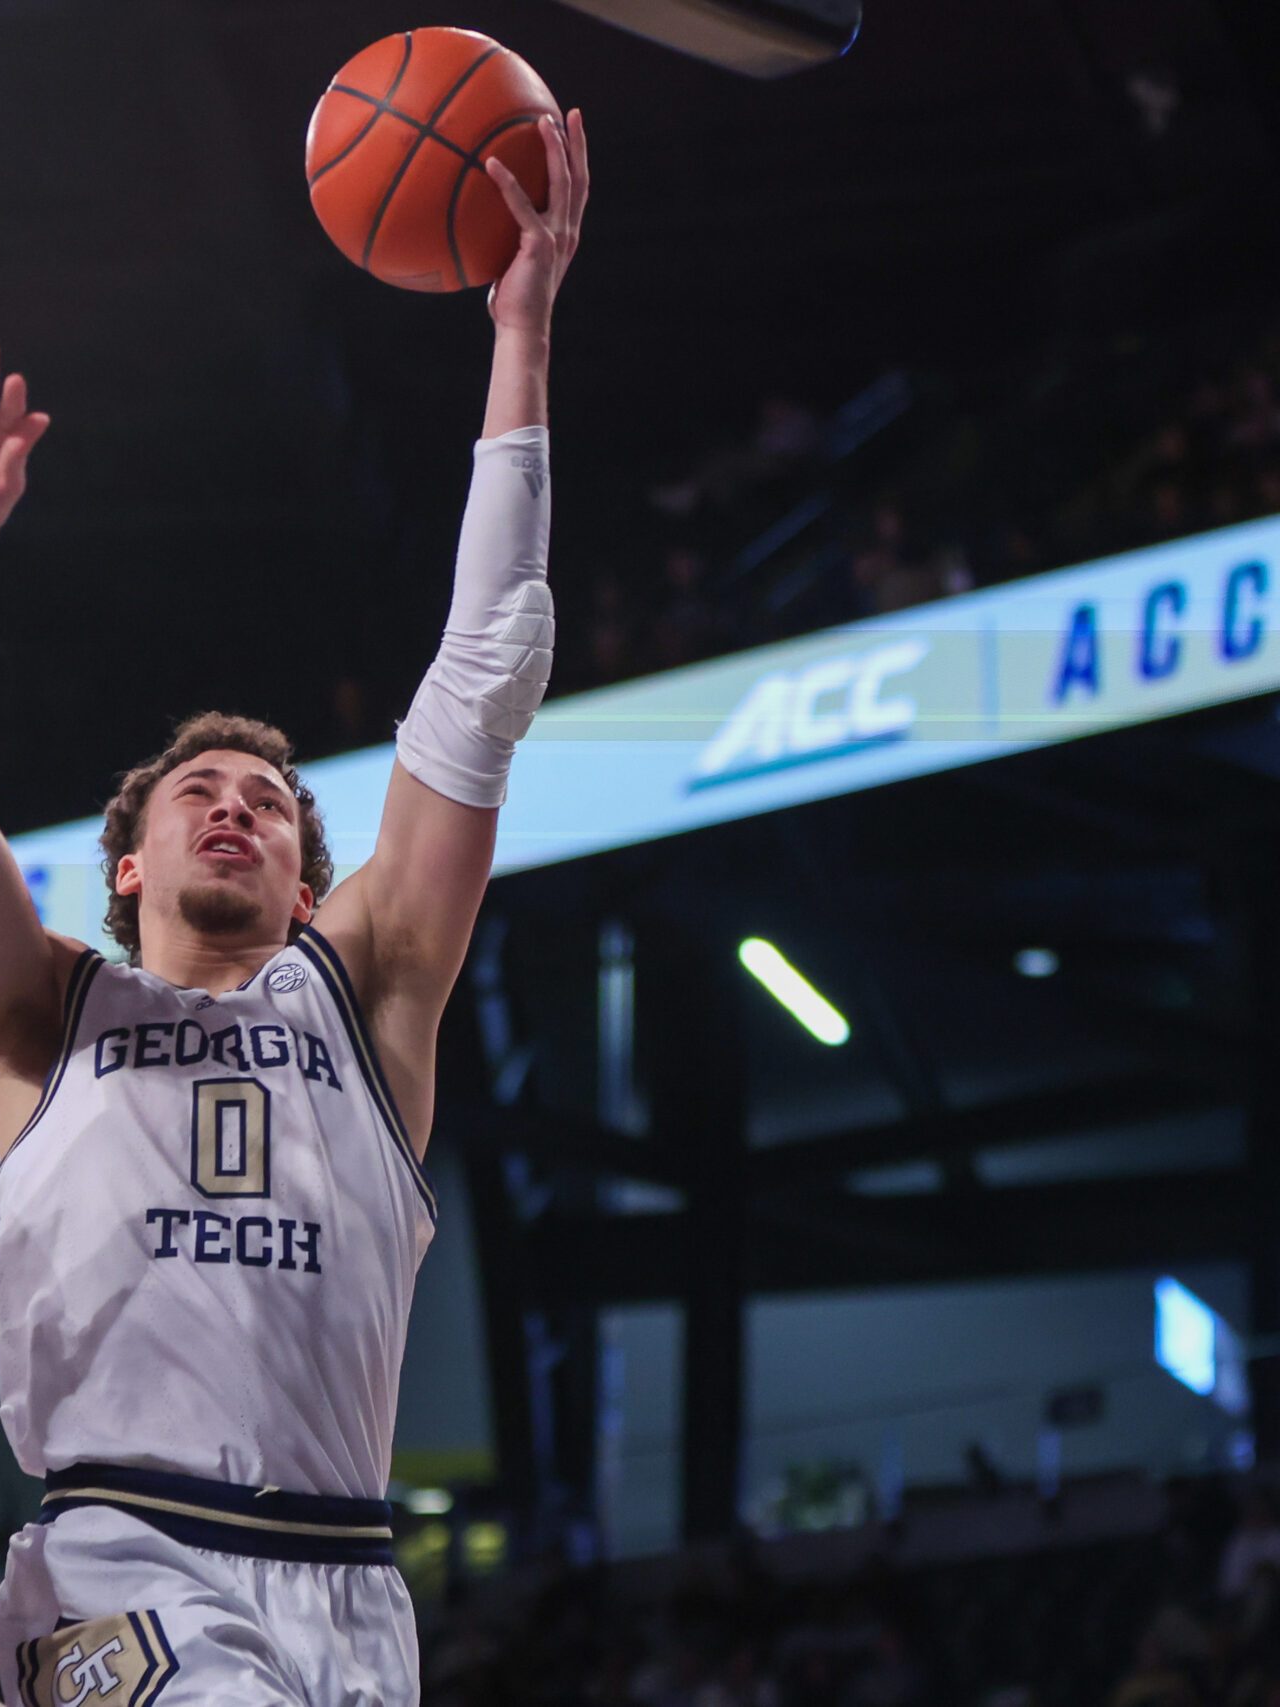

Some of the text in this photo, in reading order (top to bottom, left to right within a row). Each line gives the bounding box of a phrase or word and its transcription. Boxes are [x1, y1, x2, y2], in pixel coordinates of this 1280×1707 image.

[696, 637, 931, 776] ACC
[190, 1076, 271, 1199] 0
[145, 1207, 322, 1274] TECH
